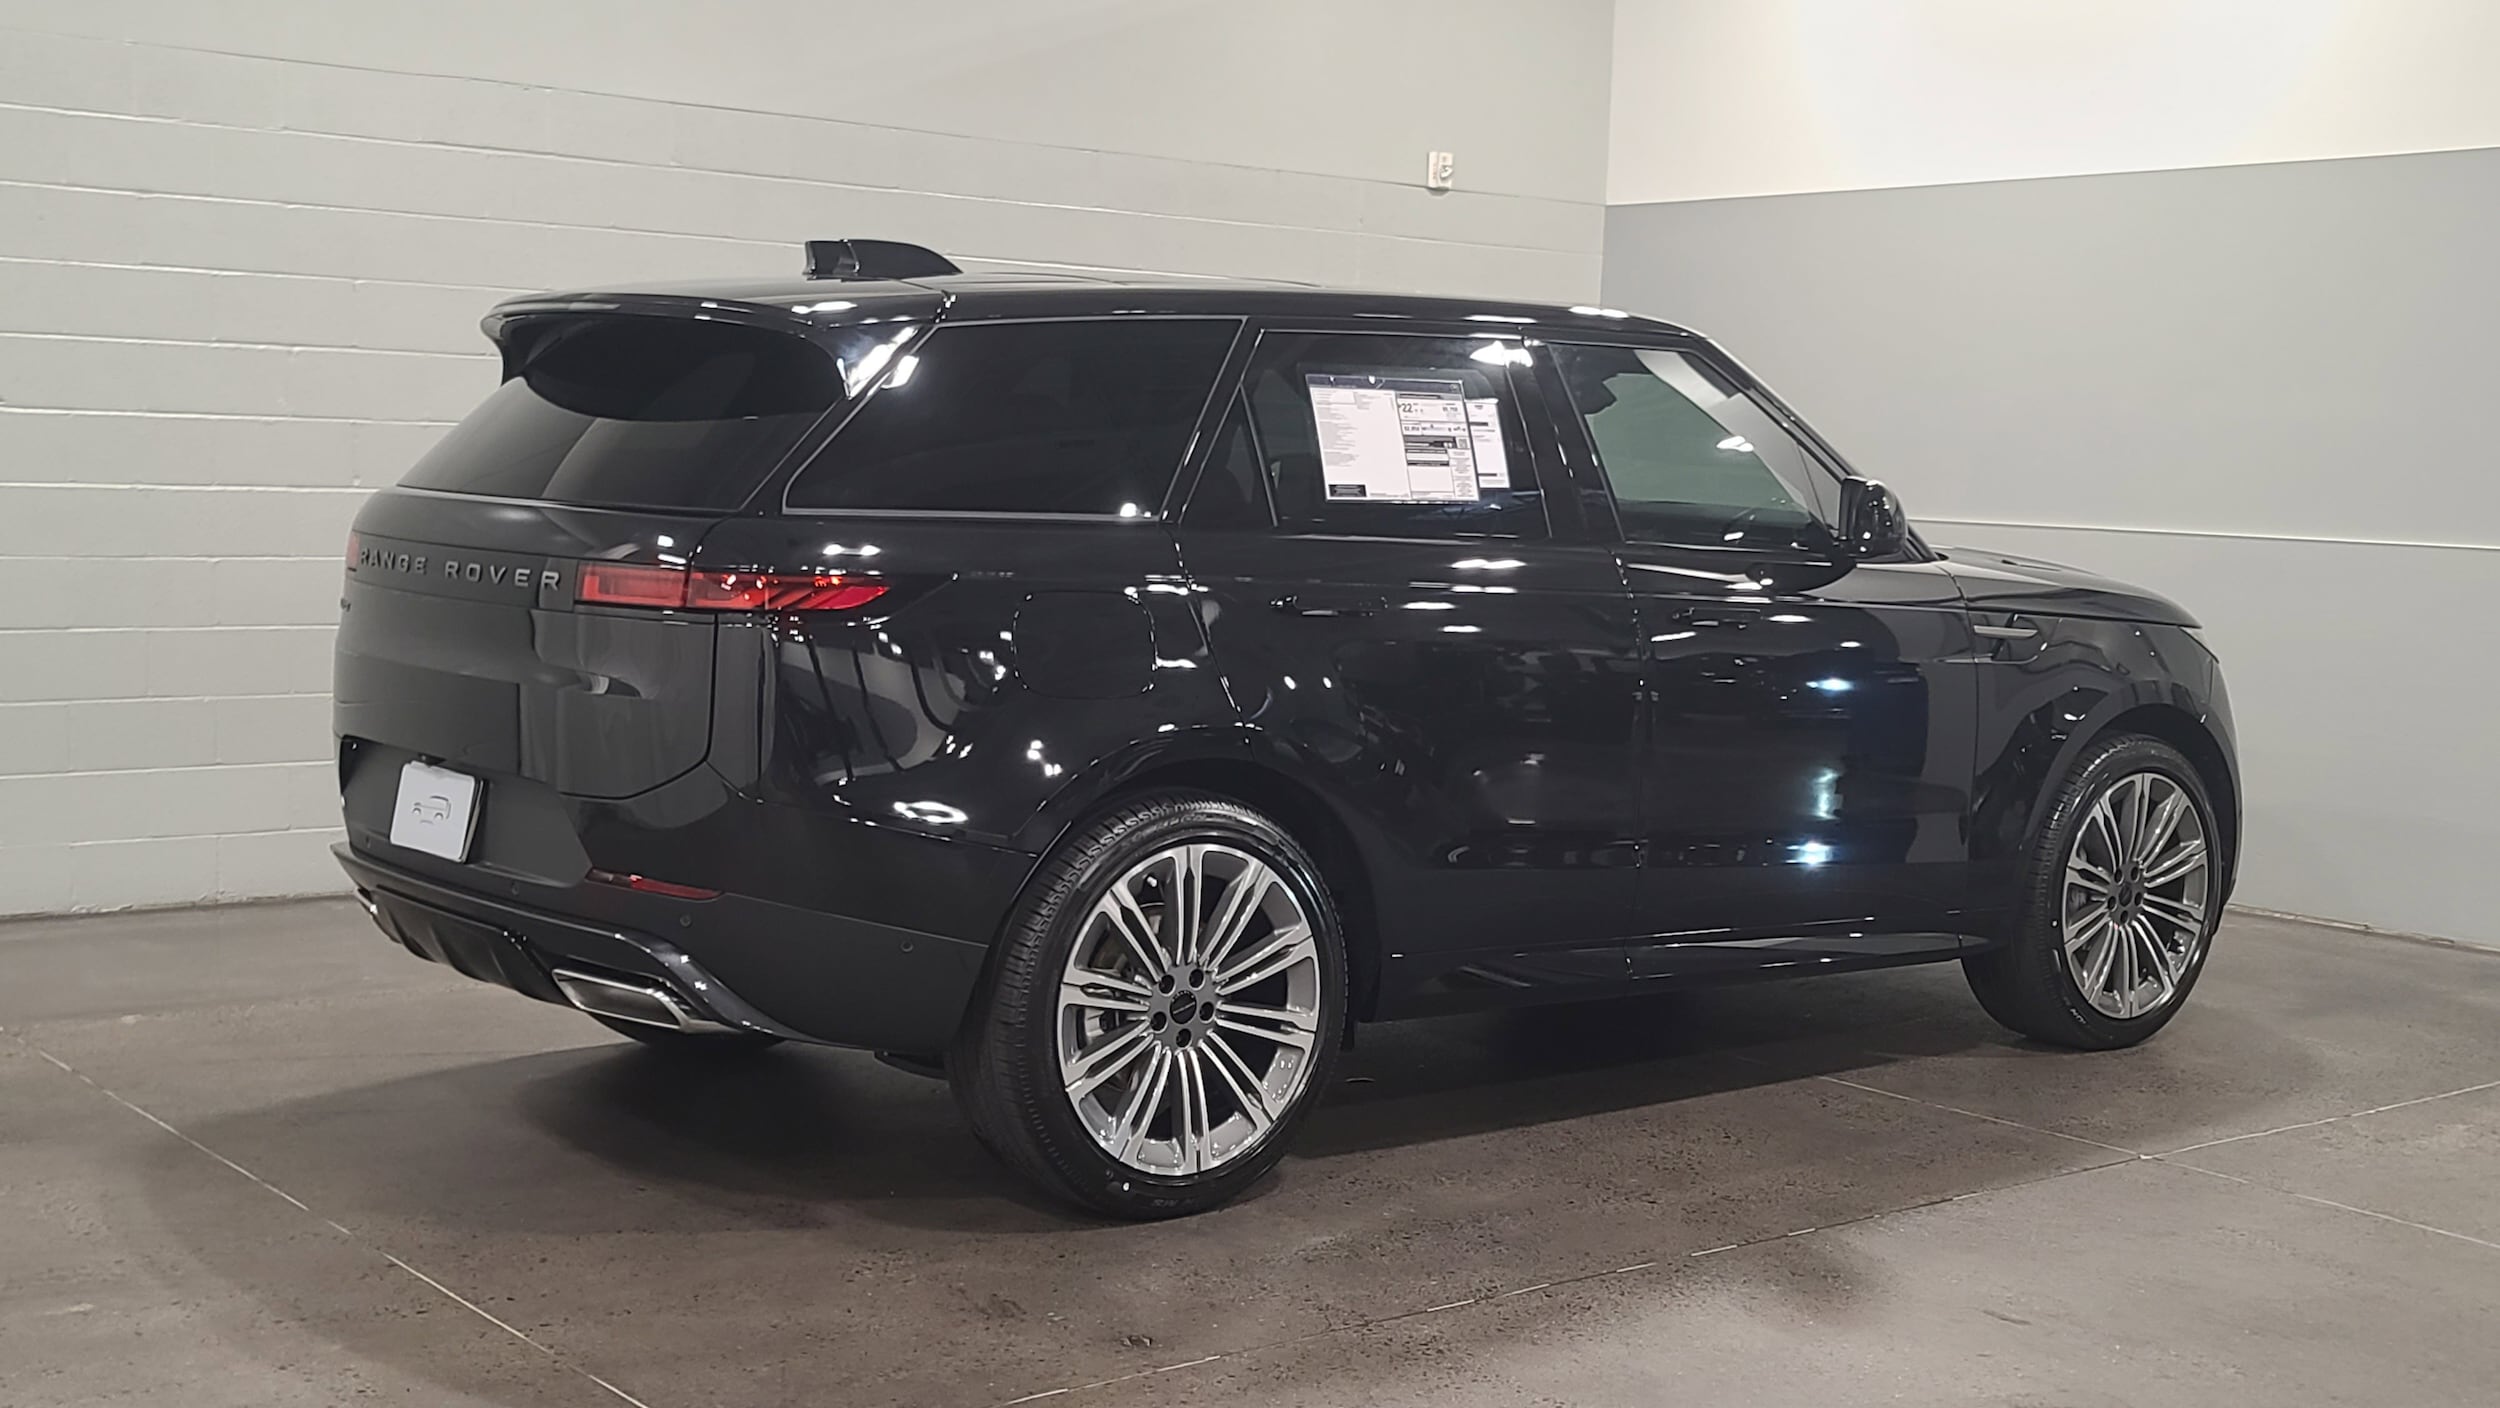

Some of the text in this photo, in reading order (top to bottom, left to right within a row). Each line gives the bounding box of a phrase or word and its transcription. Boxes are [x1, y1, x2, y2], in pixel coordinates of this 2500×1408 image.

[1401, 403, 1413, 413] 22
[360, 547, 561, 590] RANGE ROVER
